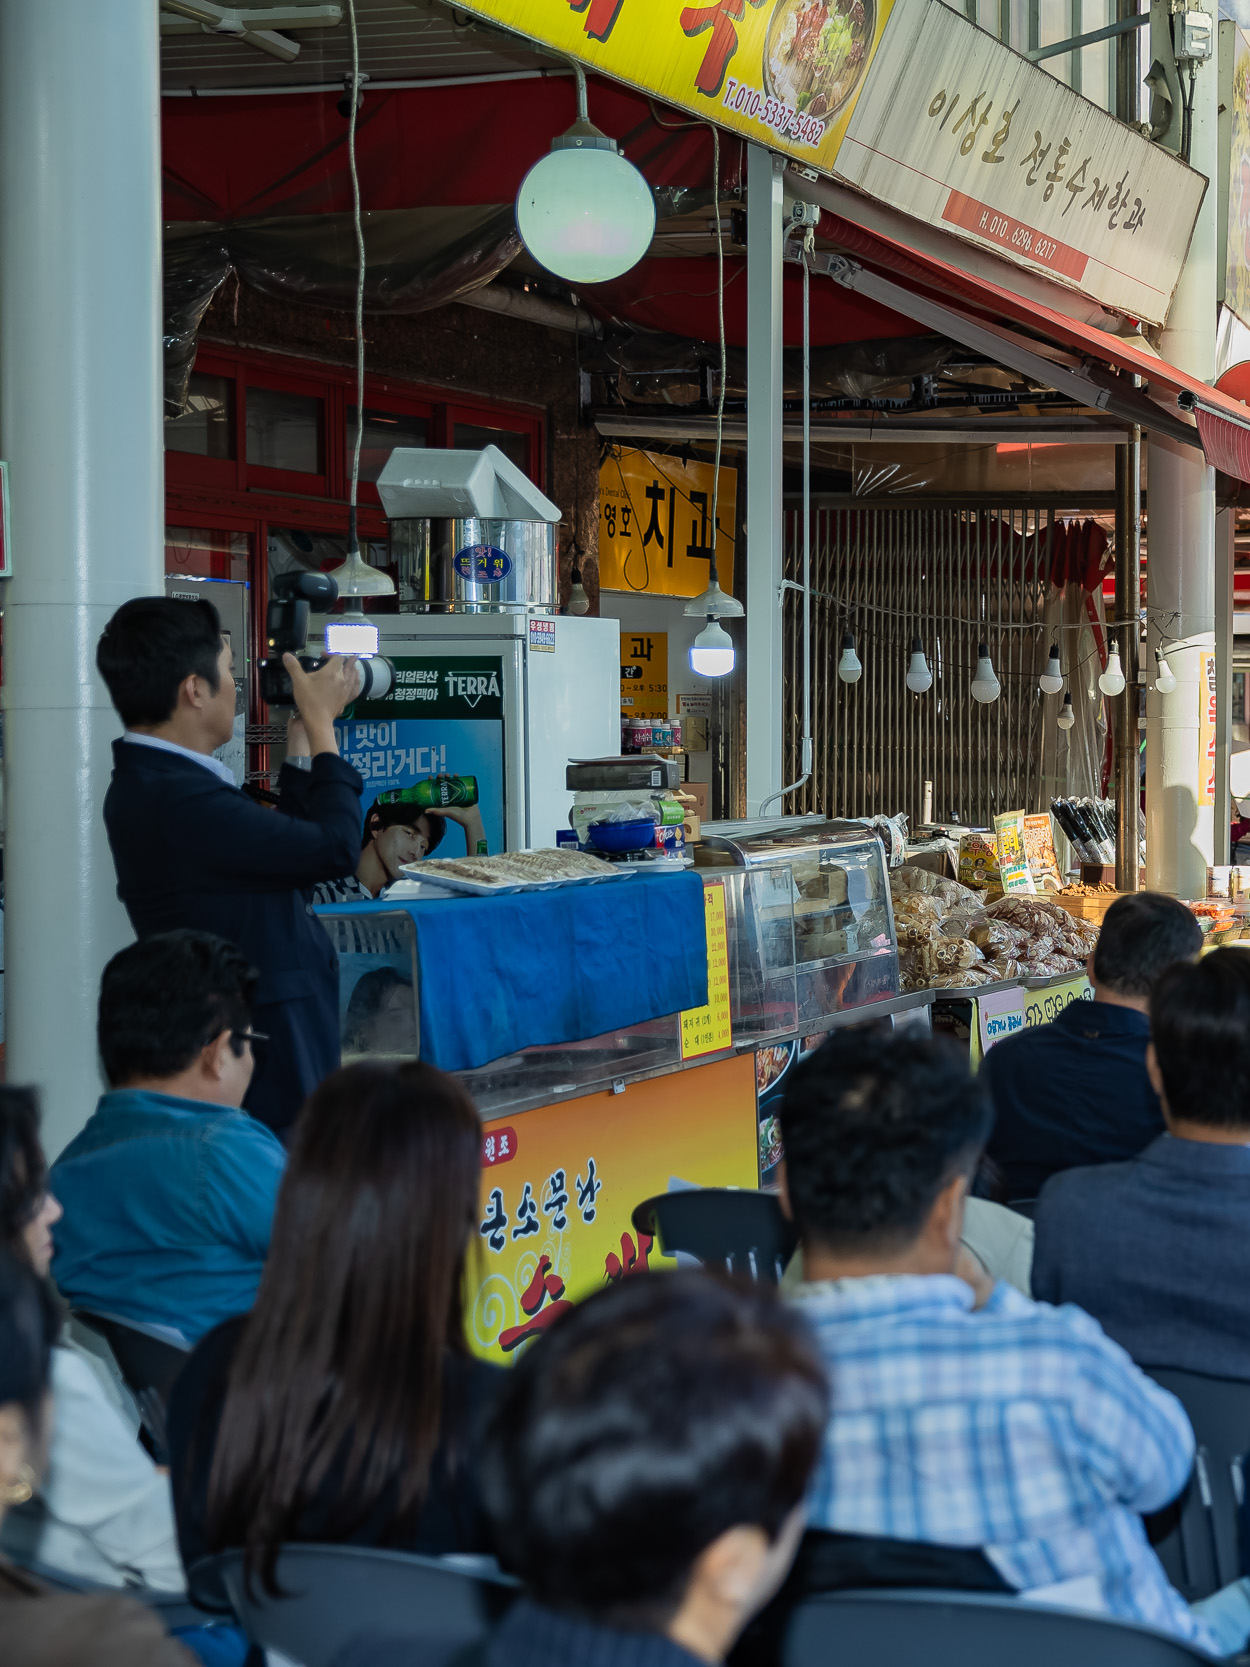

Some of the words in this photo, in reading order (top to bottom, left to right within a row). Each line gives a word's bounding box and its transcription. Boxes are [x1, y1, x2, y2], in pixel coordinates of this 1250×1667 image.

[723, 80, 825, 146] T.010-5337-5482
[928, 89, 1020, 164] 이상호
[1034, 236, 1057, 261] 6217
[600, 503, 632, 539] 영호
[643, 480, 720, 568] 치과
[394, 688, 439, 700] 청정맥아
[445, 676, 500, 697] TERRA
[649, 684, 667, 692] 5:30
[355, 722, 397, 752] 맛이
[344, 745, 447, 780] 정라거다!
[440, 780, 450, 806] TERRA
[717, 1011, 728, 1022] 6,000
[718, 1028, 729, 1039] 4,000
[484, 1134, 510, 1162] 원조
[480, 1156, 602, 1254] 큰소문난
